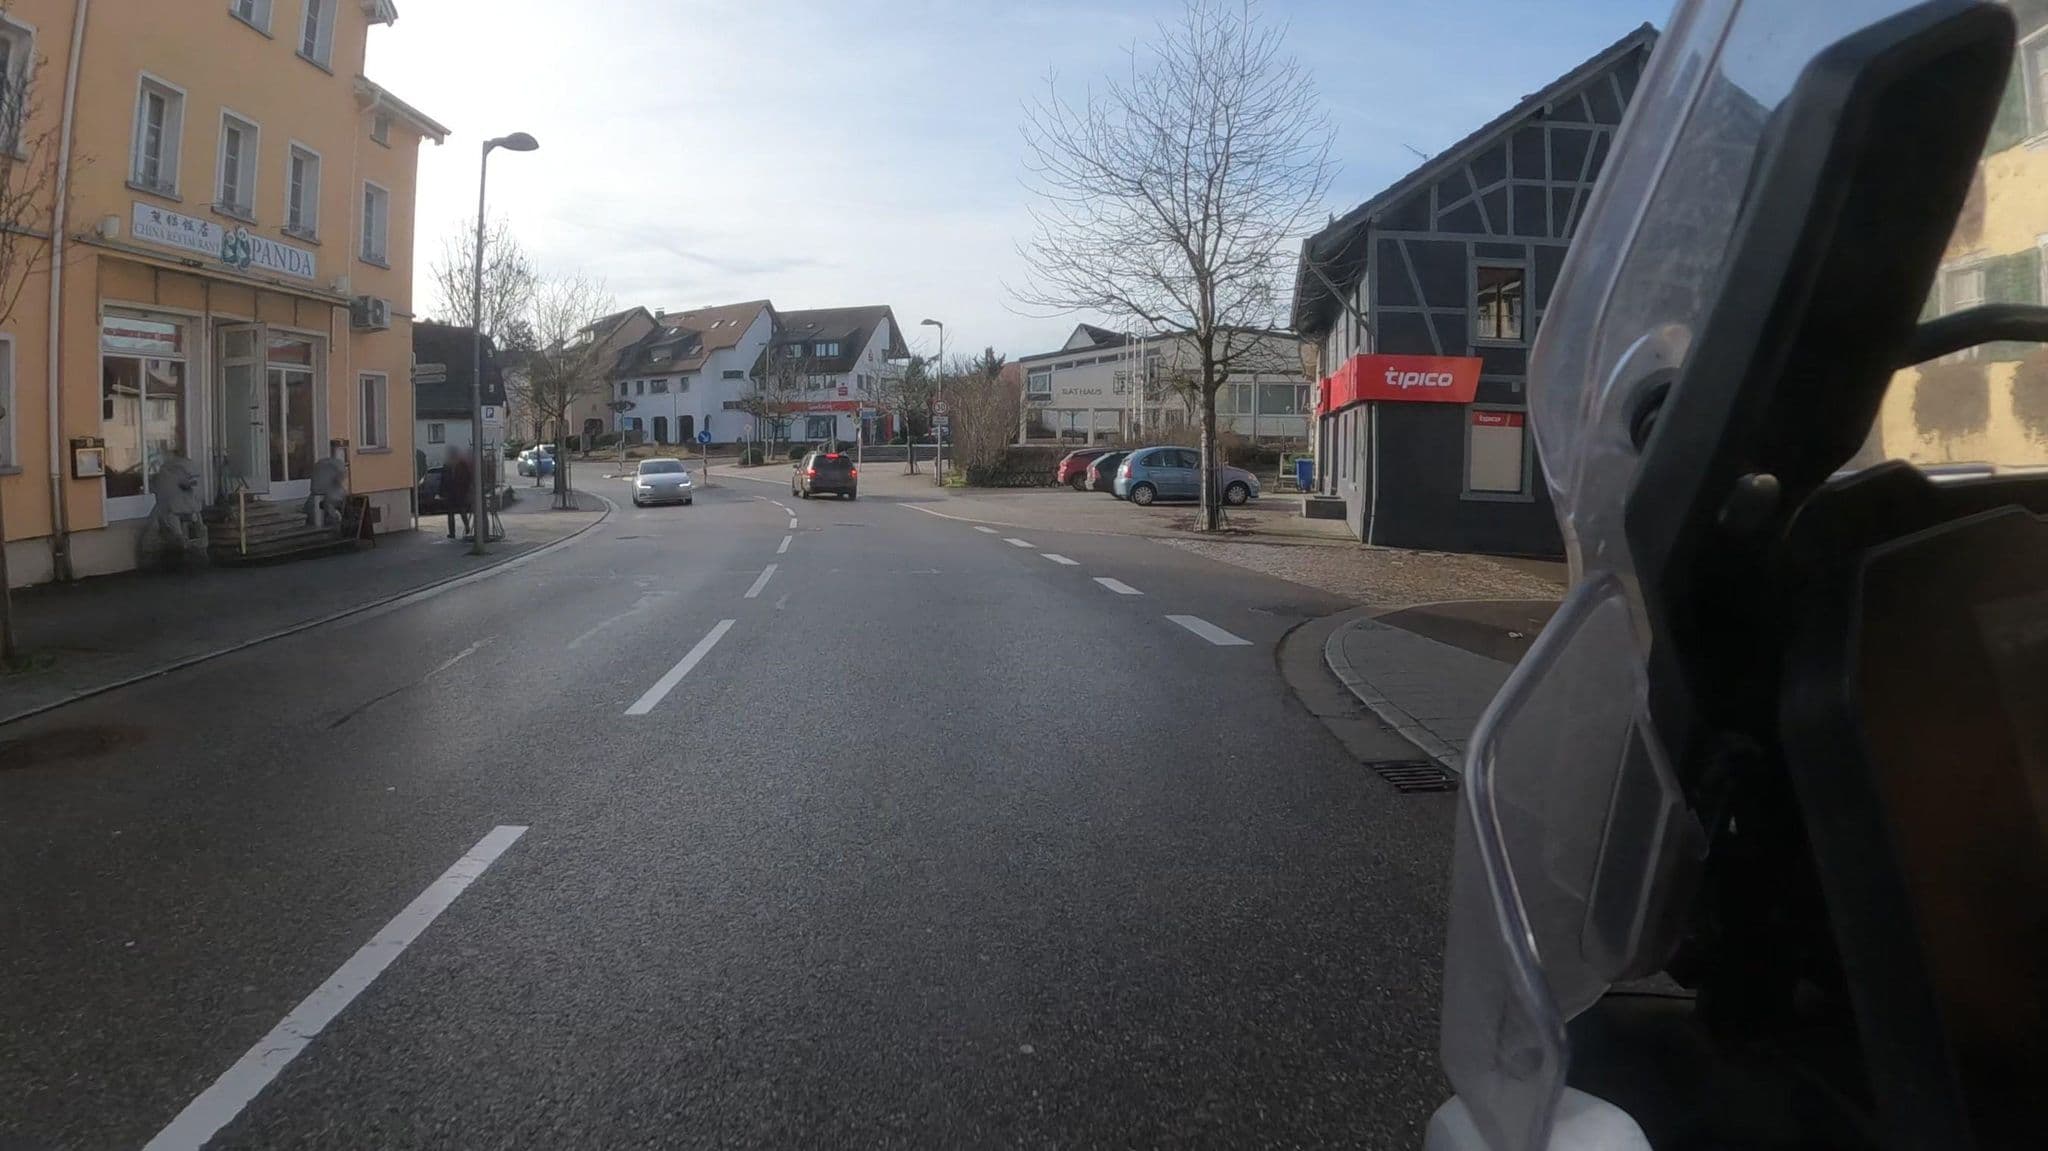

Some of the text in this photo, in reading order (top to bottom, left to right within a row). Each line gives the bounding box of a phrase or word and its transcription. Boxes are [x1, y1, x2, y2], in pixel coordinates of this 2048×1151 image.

[134, 223, 220, 252] CHINA RESTAURANT
[252, 238, 313, 277] PANDA
[1384, 367, 1453, 389] tipico
